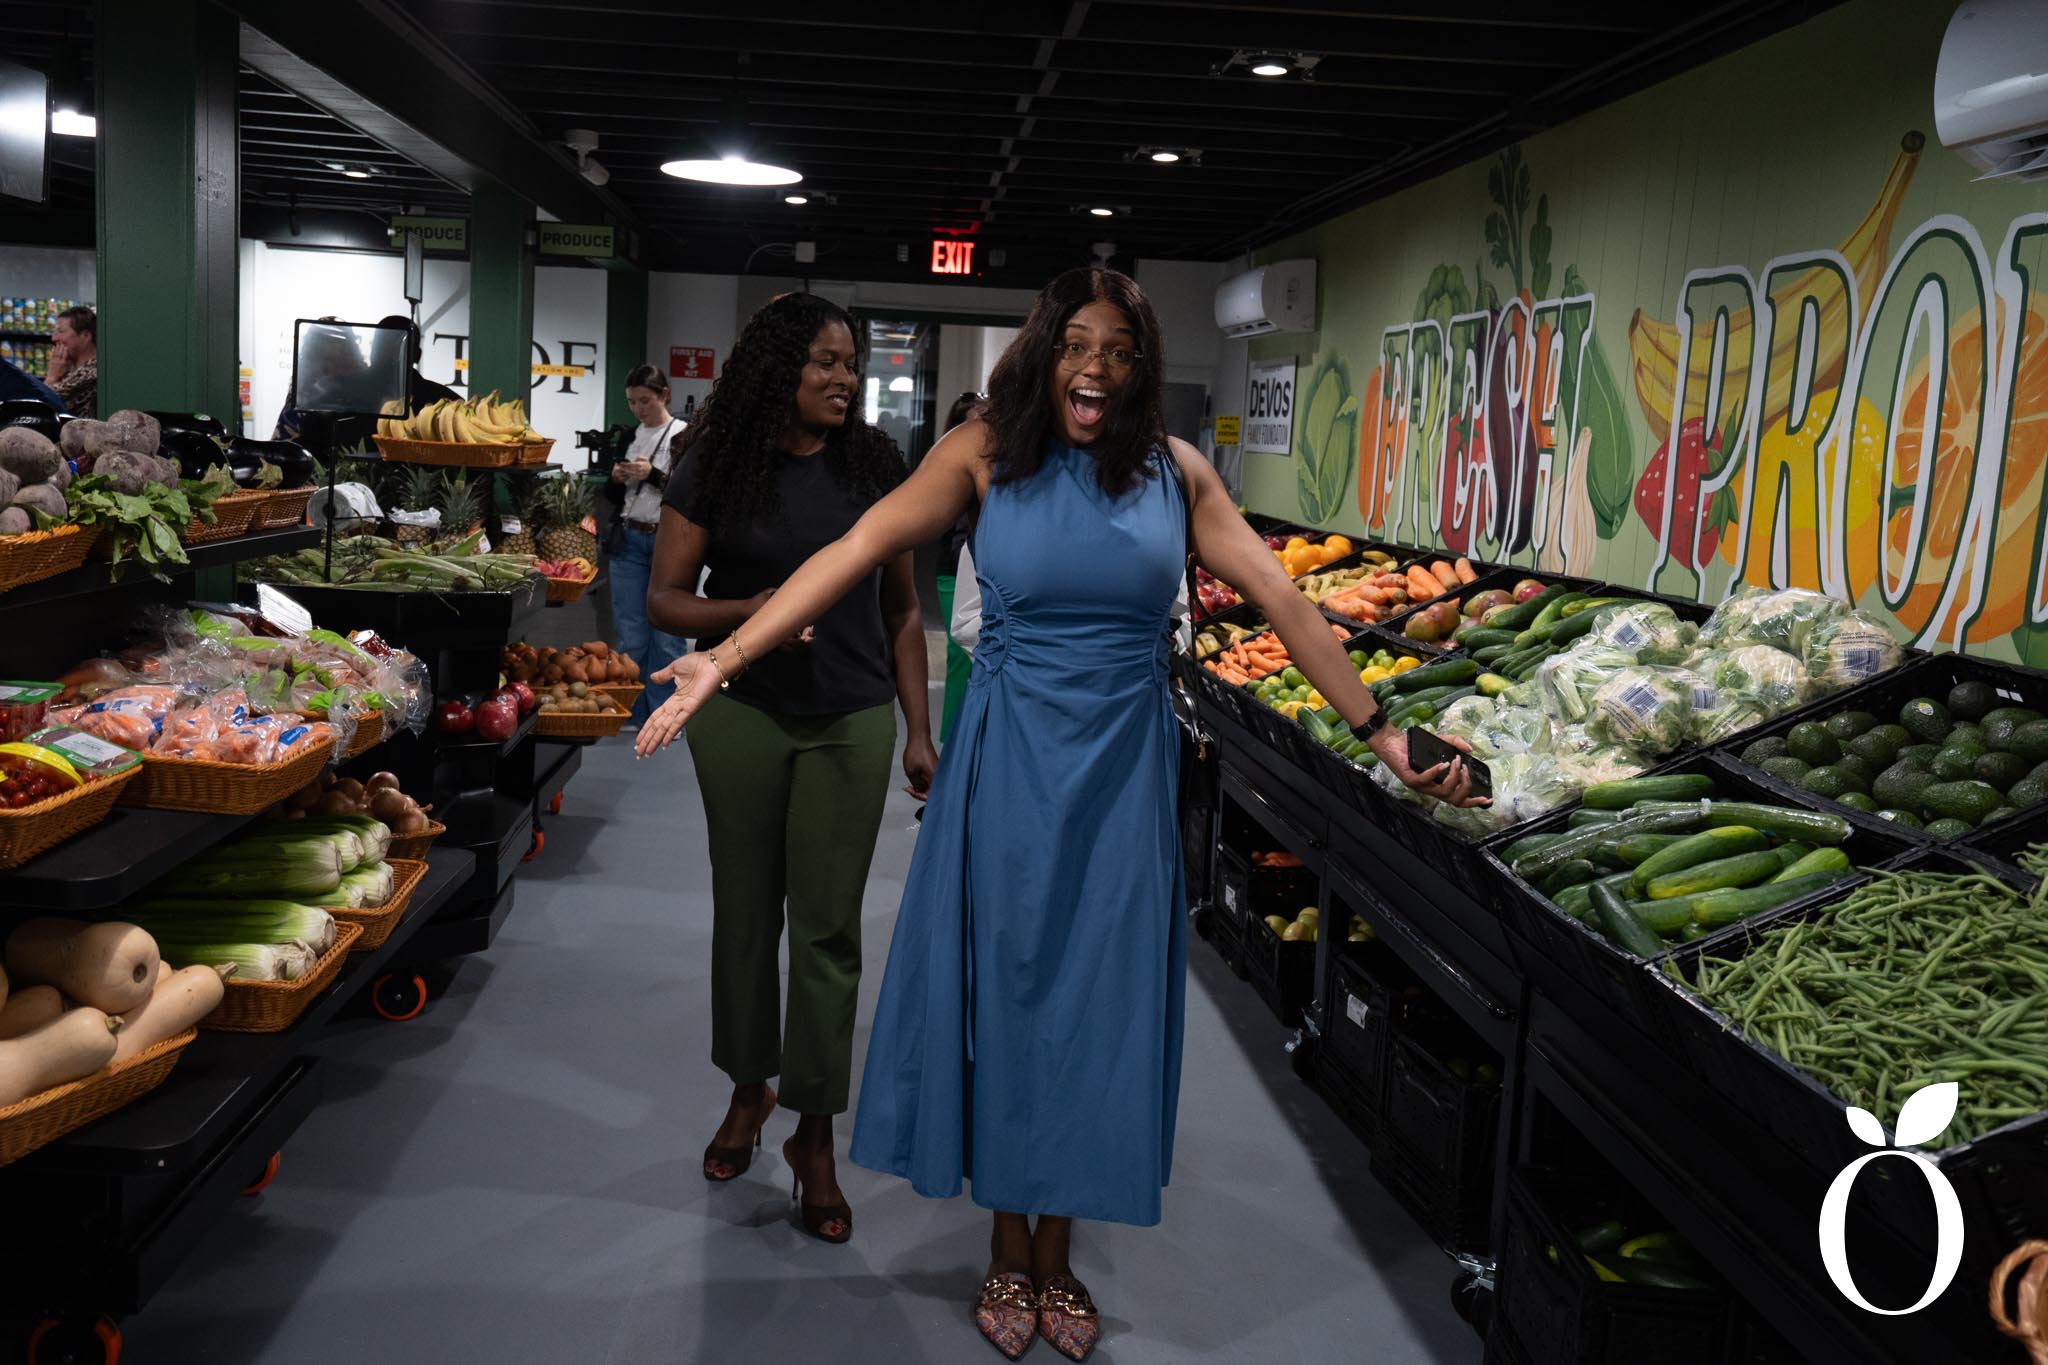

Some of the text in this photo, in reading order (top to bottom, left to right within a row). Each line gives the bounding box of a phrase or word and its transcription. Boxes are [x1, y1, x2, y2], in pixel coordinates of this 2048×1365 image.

[543, 232, 612, 248] PRODUCE
[931, 240, 975, 275] EXIT
[1365, 293, 1596, 576] FRESH
